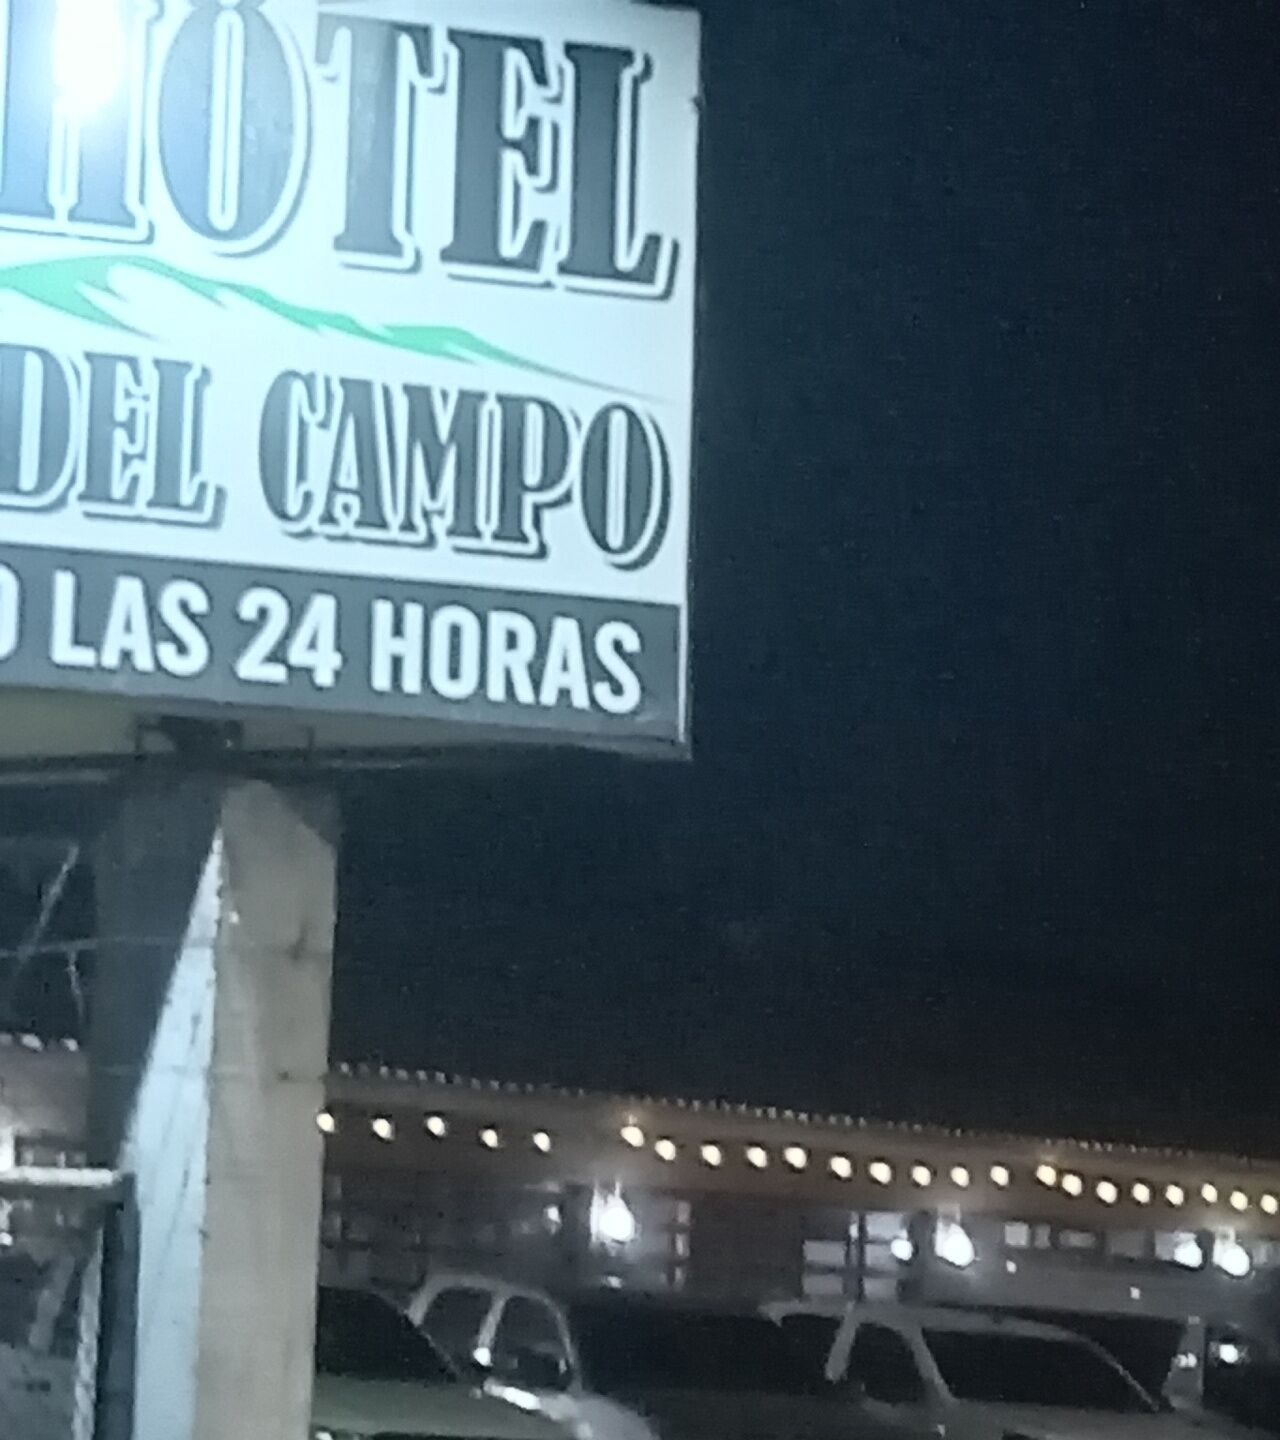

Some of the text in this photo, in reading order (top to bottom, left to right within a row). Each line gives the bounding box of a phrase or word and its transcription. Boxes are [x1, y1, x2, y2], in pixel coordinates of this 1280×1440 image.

[0, 0, 679, 302] HOTEL
[0, 341, 672, 572] DEL CAMPO
[50, 568, 210, 677] LAS
[236, 586, 342, 688] 24
[370, 598, 643, 714] HORAS
